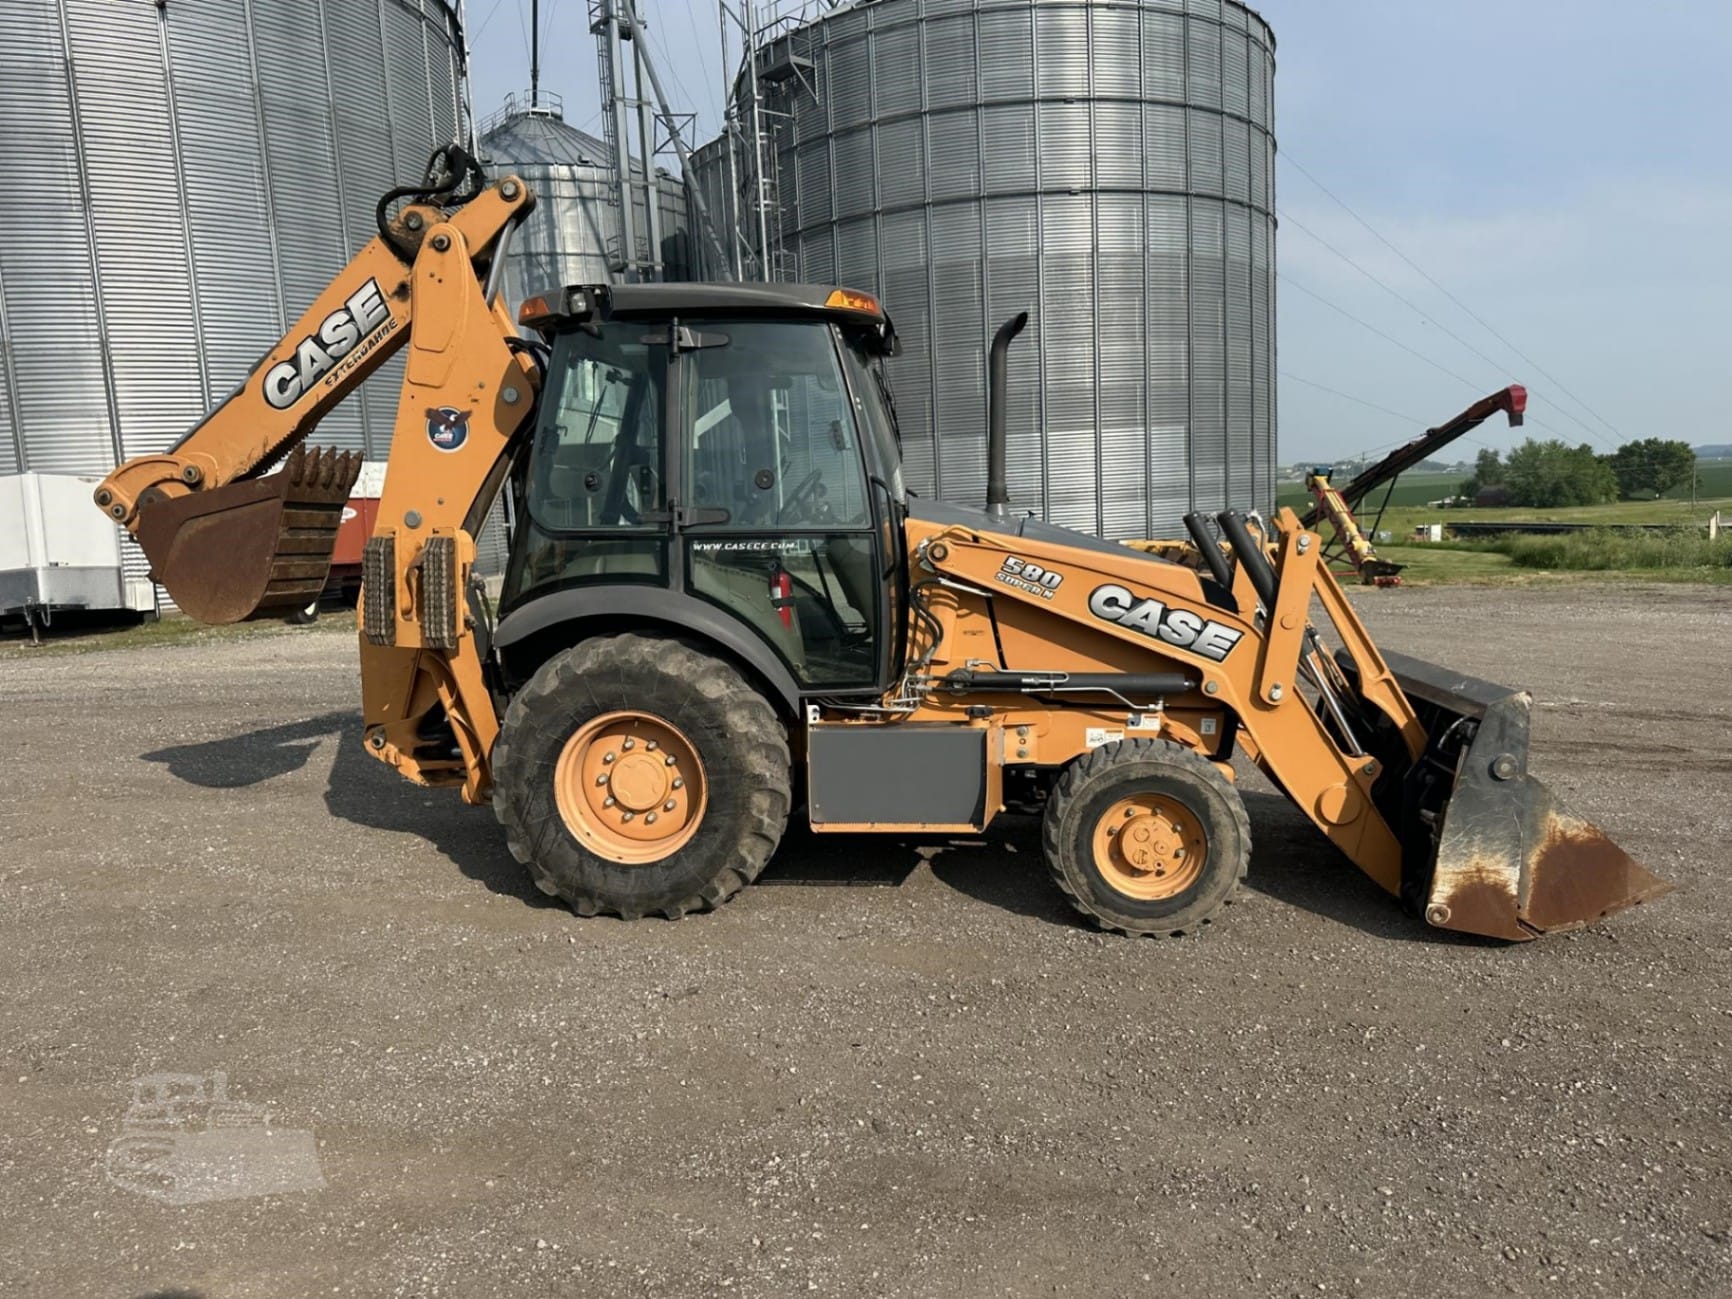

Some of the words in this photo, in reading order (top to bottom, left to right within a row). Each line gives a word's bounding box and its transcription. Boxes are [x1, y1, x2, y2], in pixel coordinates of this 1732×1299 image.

[264, 277, 390, 409] CASE
[994, 571, 1042, 596] SUPER
[1041, 588, 1056, 600] N
[1001, 555, 1064, 590] 580
[1088, 583, 1245, 663] CASE
